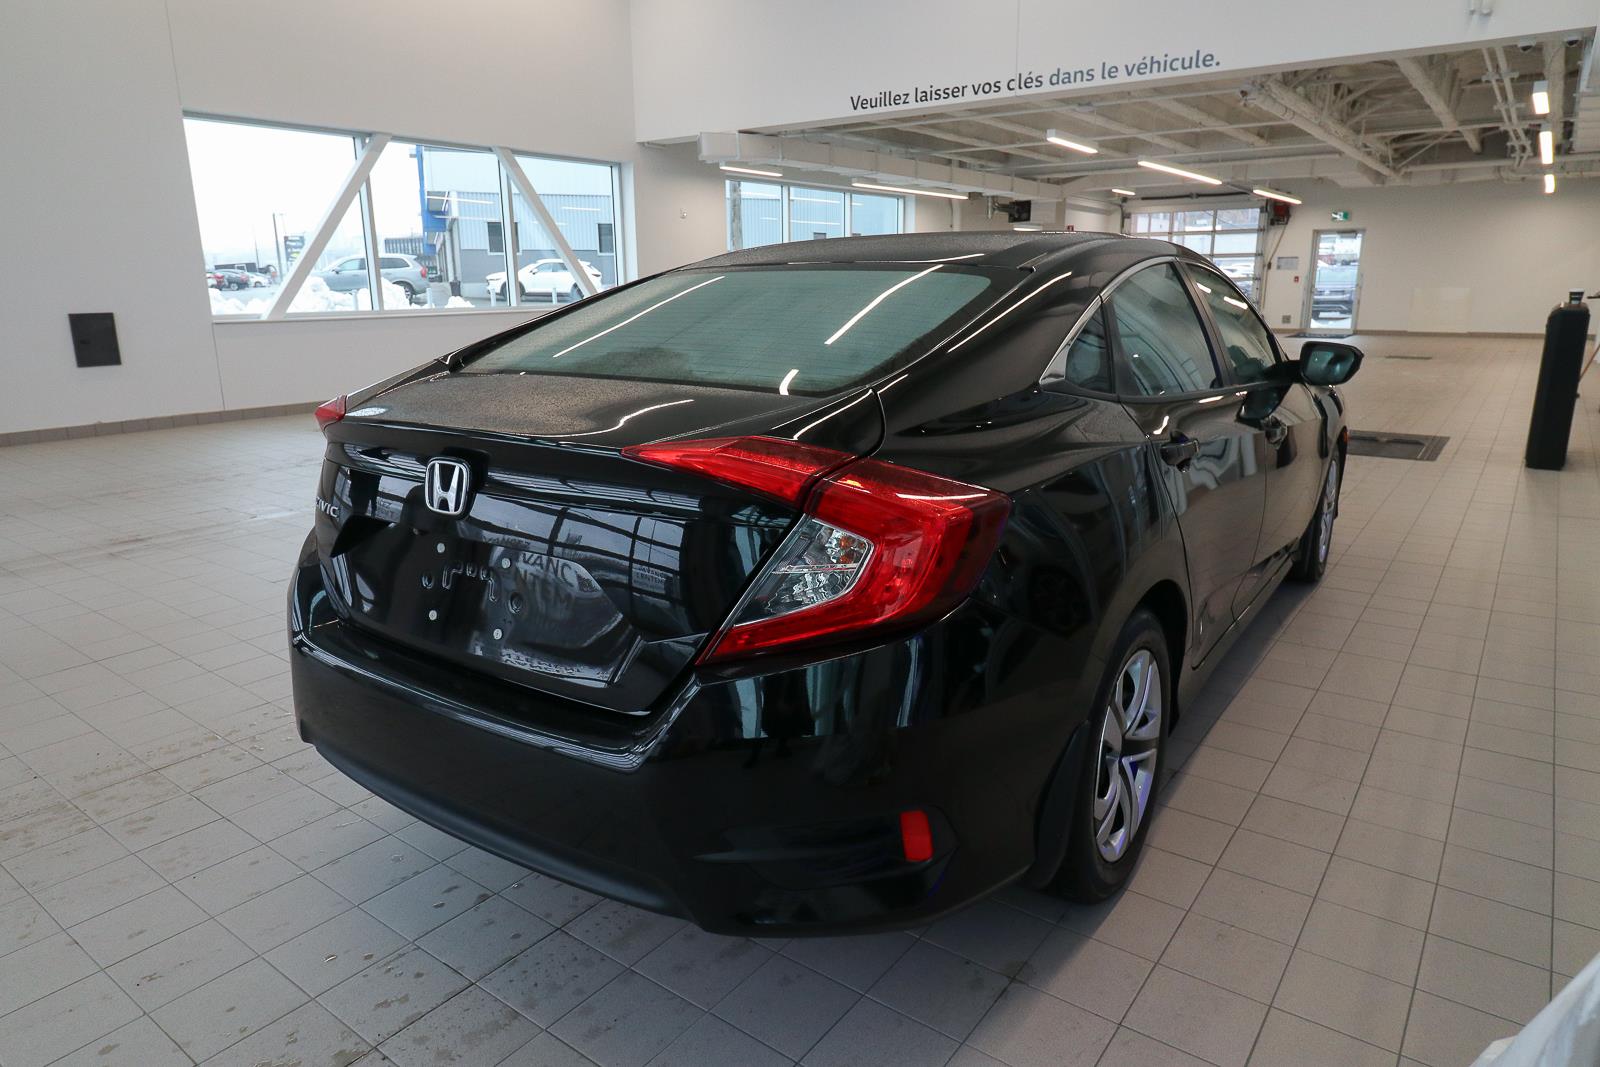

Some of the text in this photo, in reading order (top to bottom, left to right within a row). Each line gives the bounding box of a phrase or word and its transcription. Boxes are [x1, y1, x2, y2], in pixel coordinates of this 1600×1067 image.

[850, 49, 1220, 111] Veuillez laisser vos clés dans le véhicule.
